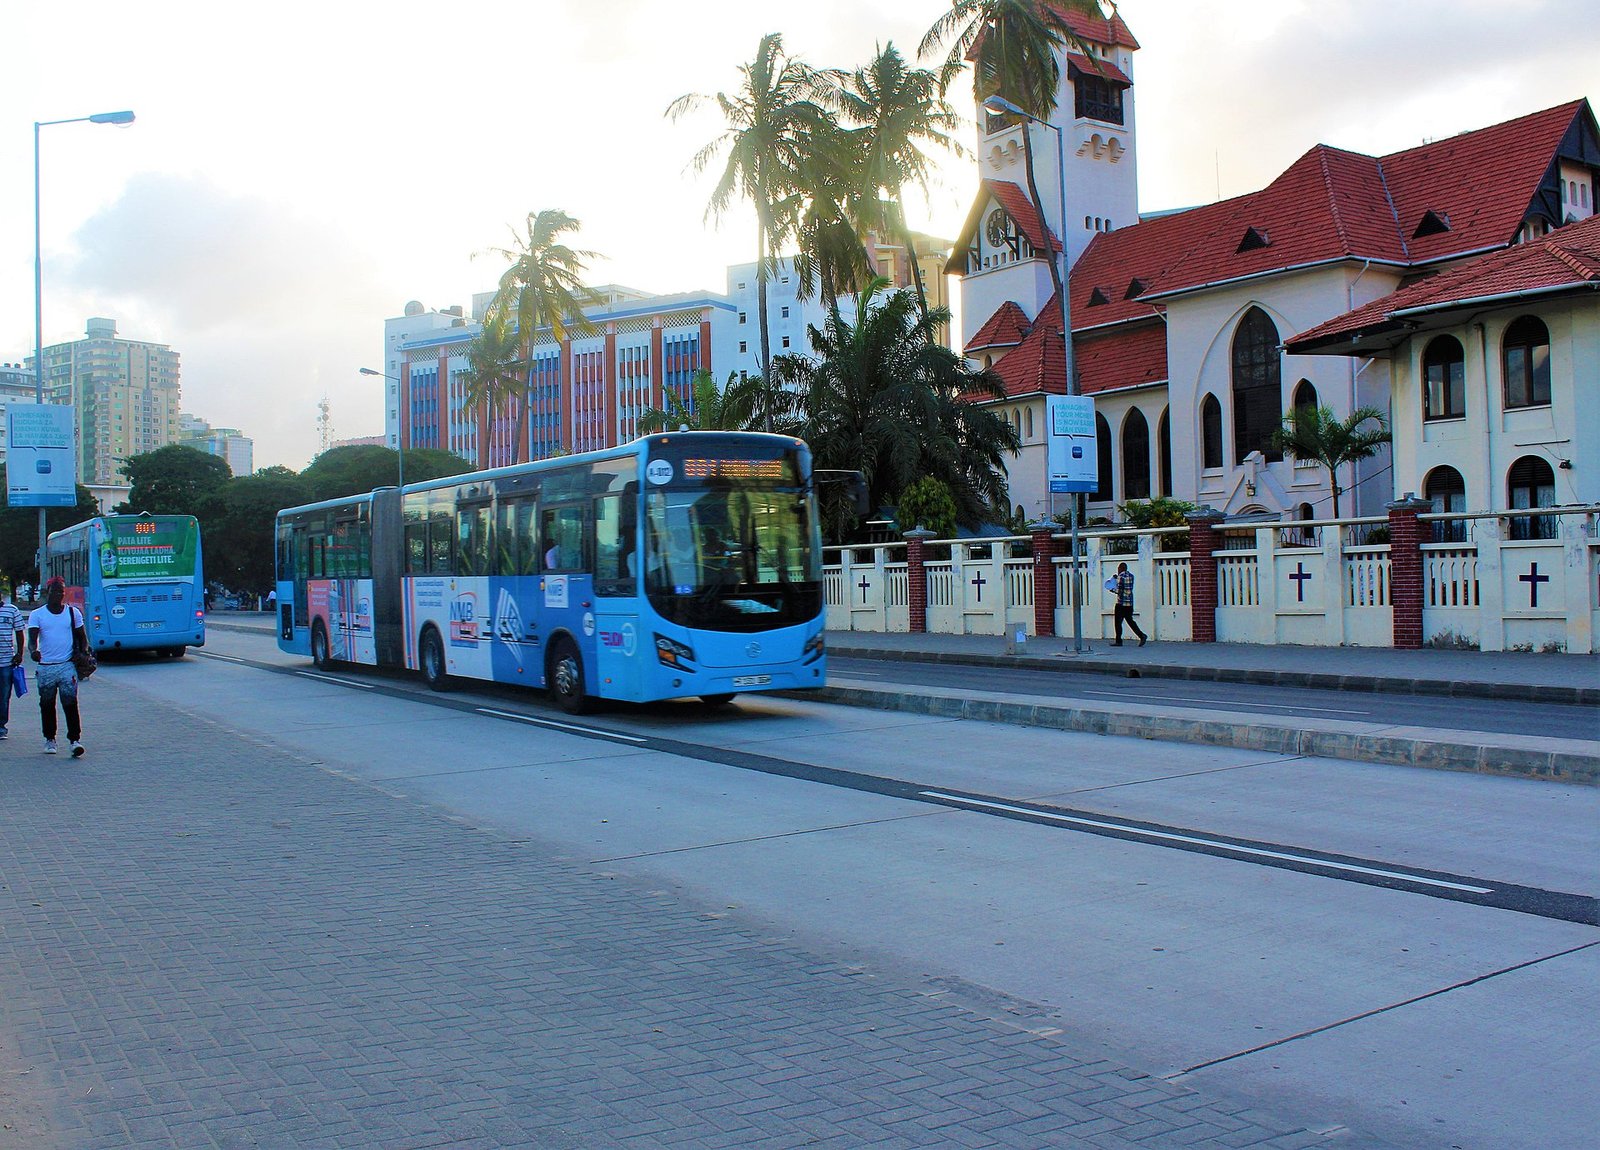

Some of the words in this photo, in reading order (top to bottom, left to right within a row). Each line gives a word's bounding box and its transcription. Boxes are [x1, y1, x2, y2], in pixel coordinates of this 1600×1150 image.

[135, 522, 156, 534] 001
[117, 536, 136, 545] PATA
[136, 536, 152, 545] LITE
[118, 556, 156, 565] SERENGETI
[450, 602, 473, 622] NMB
